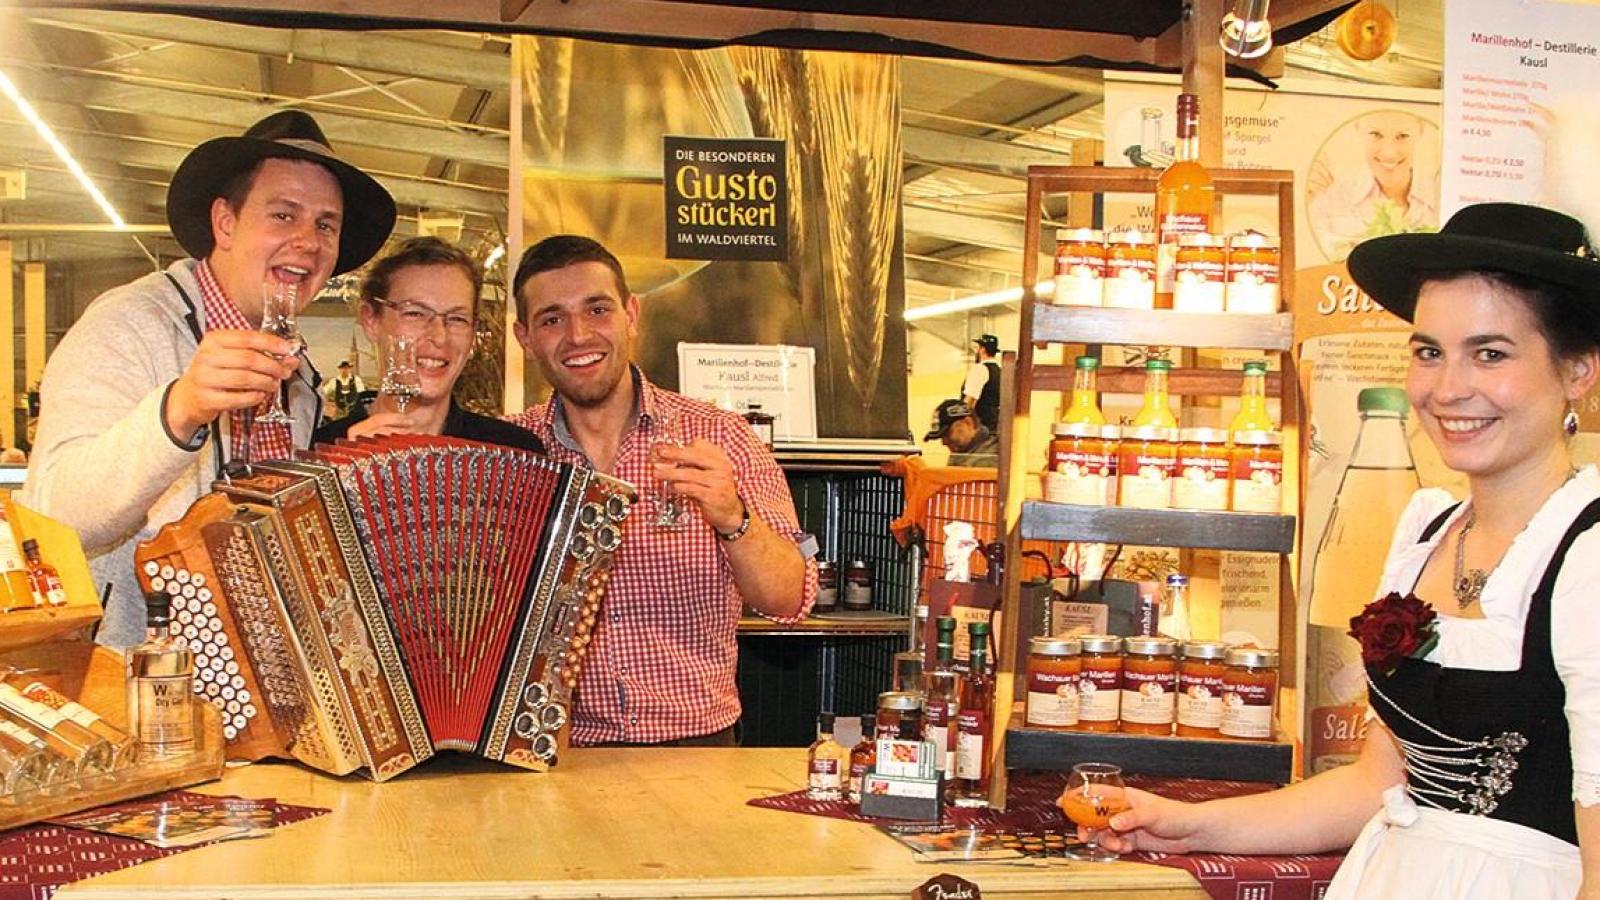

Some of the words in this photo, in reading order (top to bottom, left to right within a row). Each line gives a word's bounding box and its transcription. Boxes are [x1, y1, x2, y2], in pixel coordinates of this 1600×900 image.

[1471, 32, 1532, 50] Marillenhof
[1544, 41, 1597, 57] Destillerie
[1519, 56, 1548, 69] Kausl
[675, 149, 694, 161] DIE
[698, 151, 775, 162] BESONDEREN
[675, 164, 776, 201] Gusto
[677, 201, 776, 227] stückerl
[677, 233, 693, 244] IM
[697, 234, 776, 246] WALDVIERTEL
[1036, 672, 1073, 682] Wachauer
[153, 684, 168, 697] W
